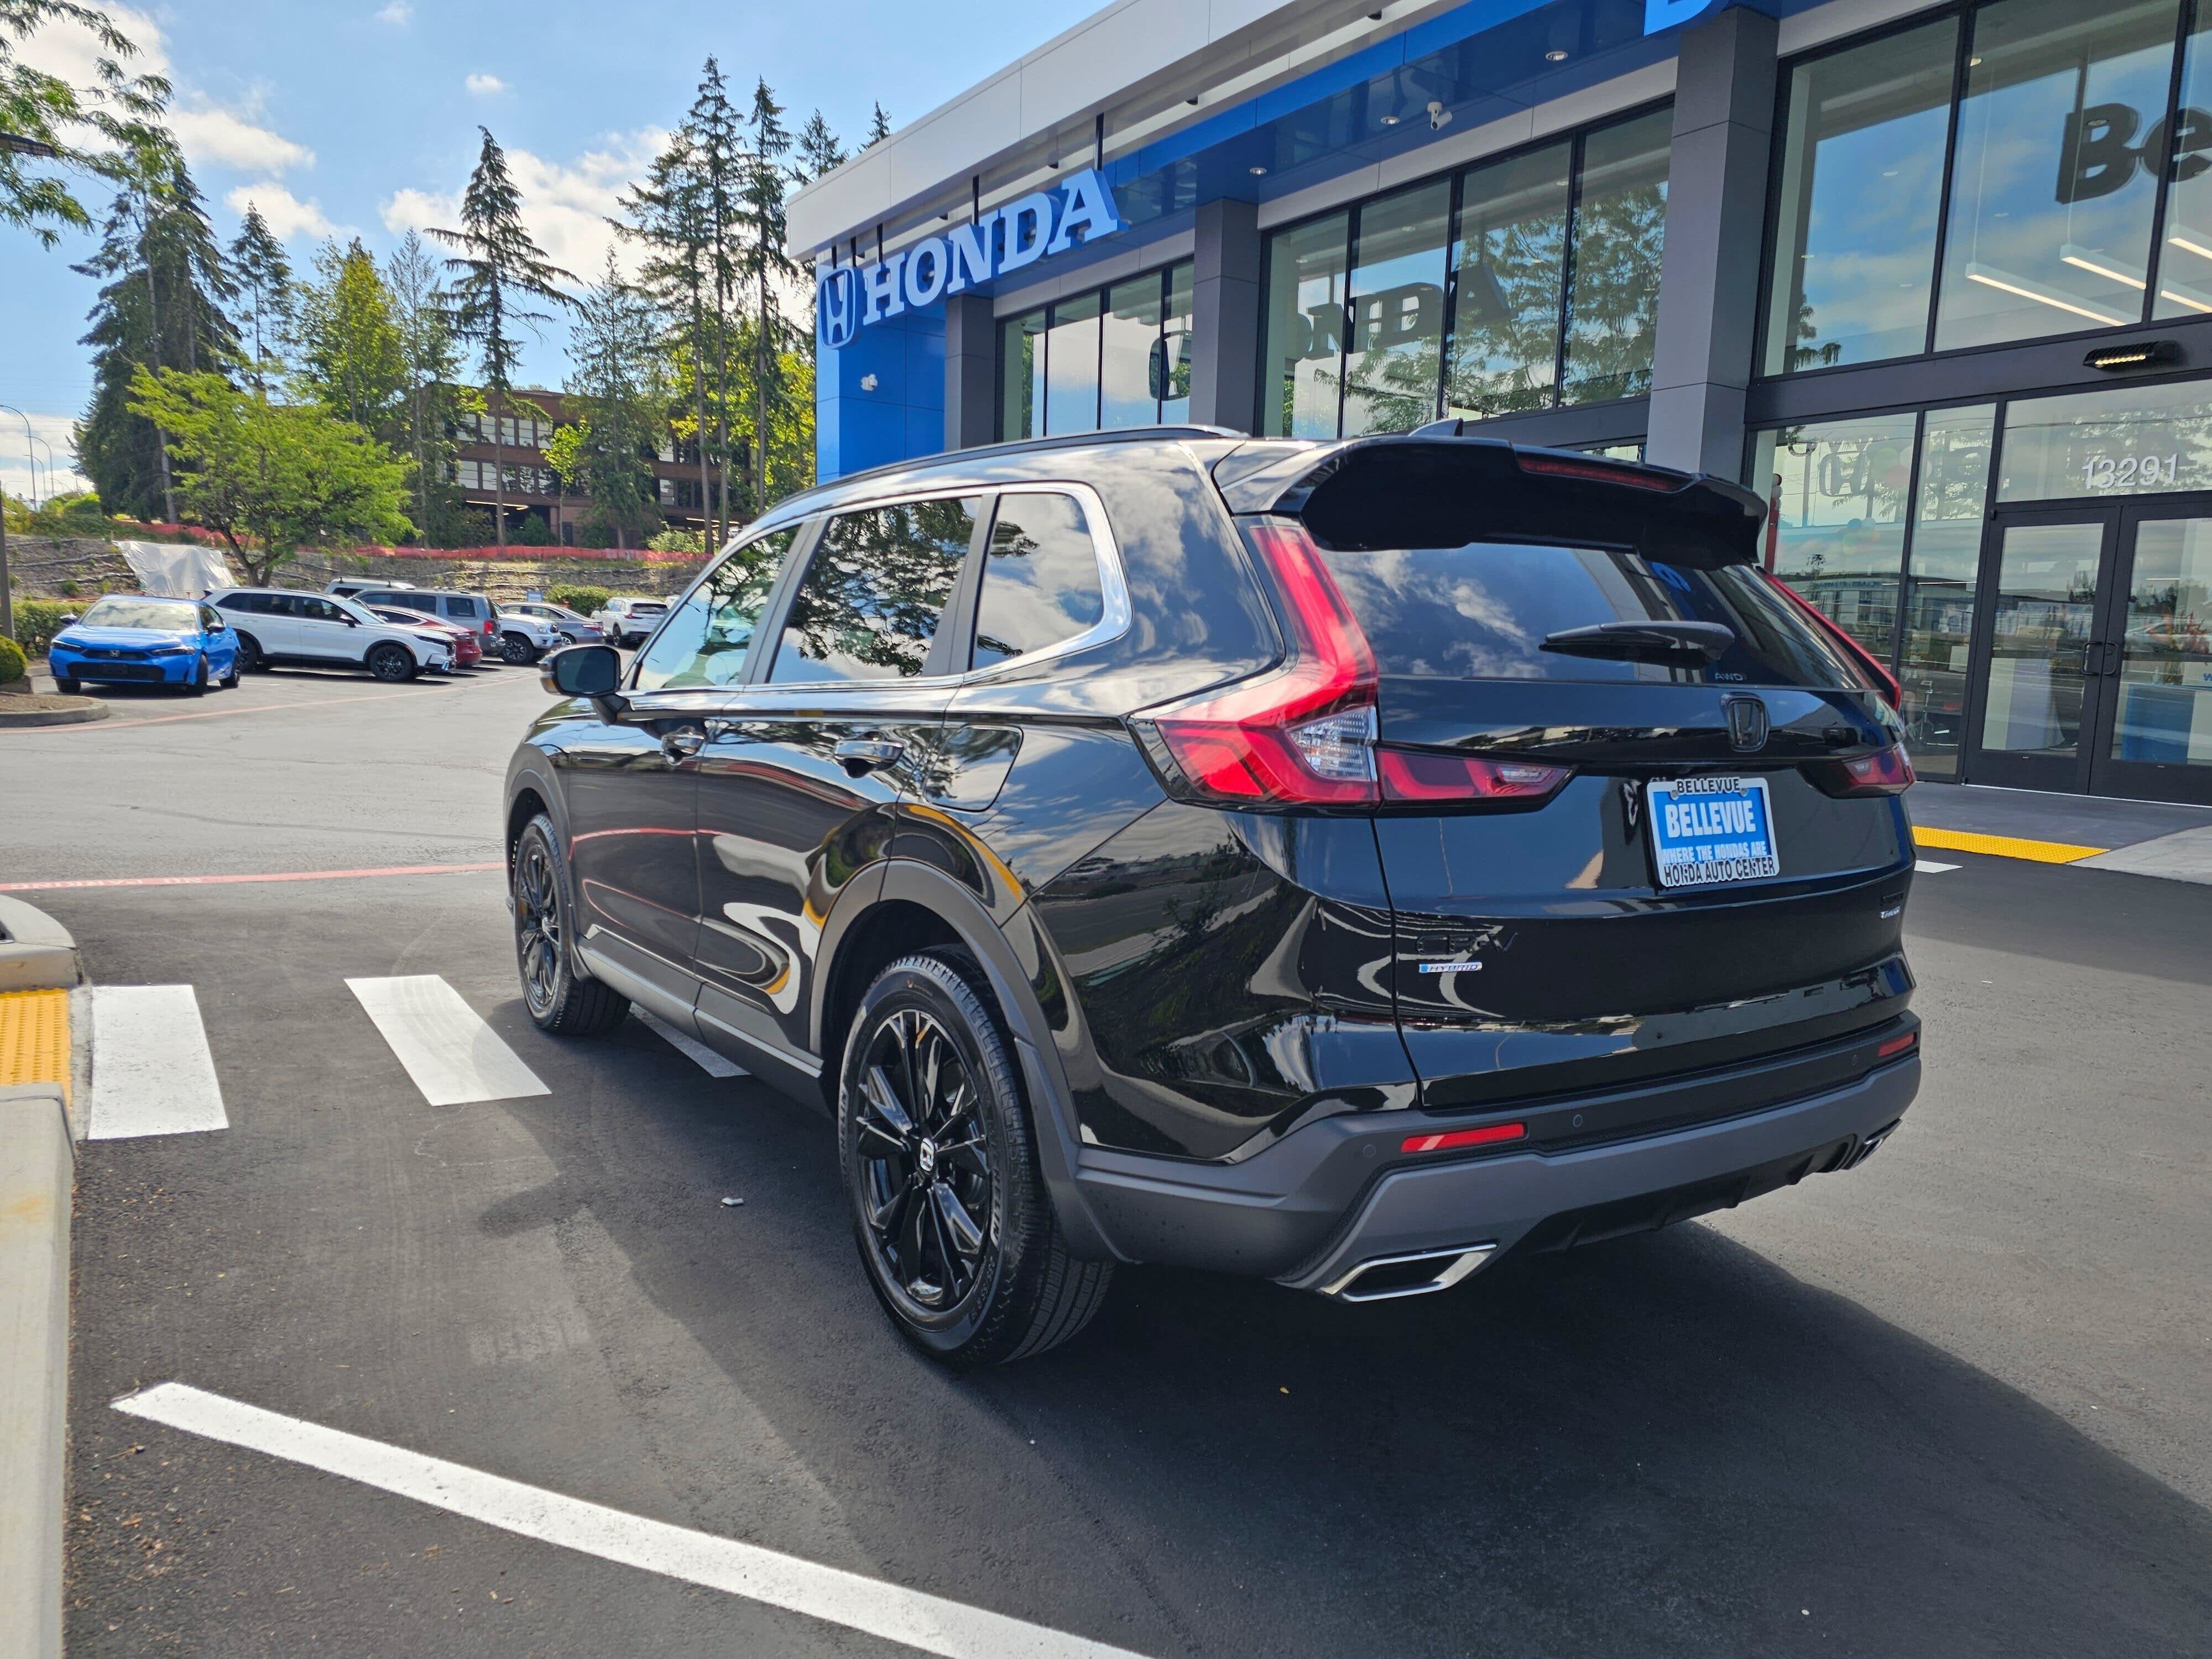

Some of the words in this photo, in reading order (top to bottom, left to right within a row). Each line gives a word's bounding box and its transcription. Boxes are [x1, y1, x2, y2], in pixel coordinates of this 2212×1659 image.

[863, 168, 1119, 326] HONDA
[2082, 454, 2178, 489] 13291
[1715, 672, 1743, 681] AWD
[1677, 779, 1740, 793] BELLEVUE
[1665, 800, 1756, 838] BELLEVUE
[1662, 847, 1695, 864] WHERE
[1696, 845, 1713, 862] THE
[1714, 842, 1749, 860] HONDAS
[1751, 841, 1767, 856] ARE
[1664, 862, 1703, 885] HONDA
[1705, 860, 1732, 881] AUTO
[1736, 857, 1776, 878] CENTER
